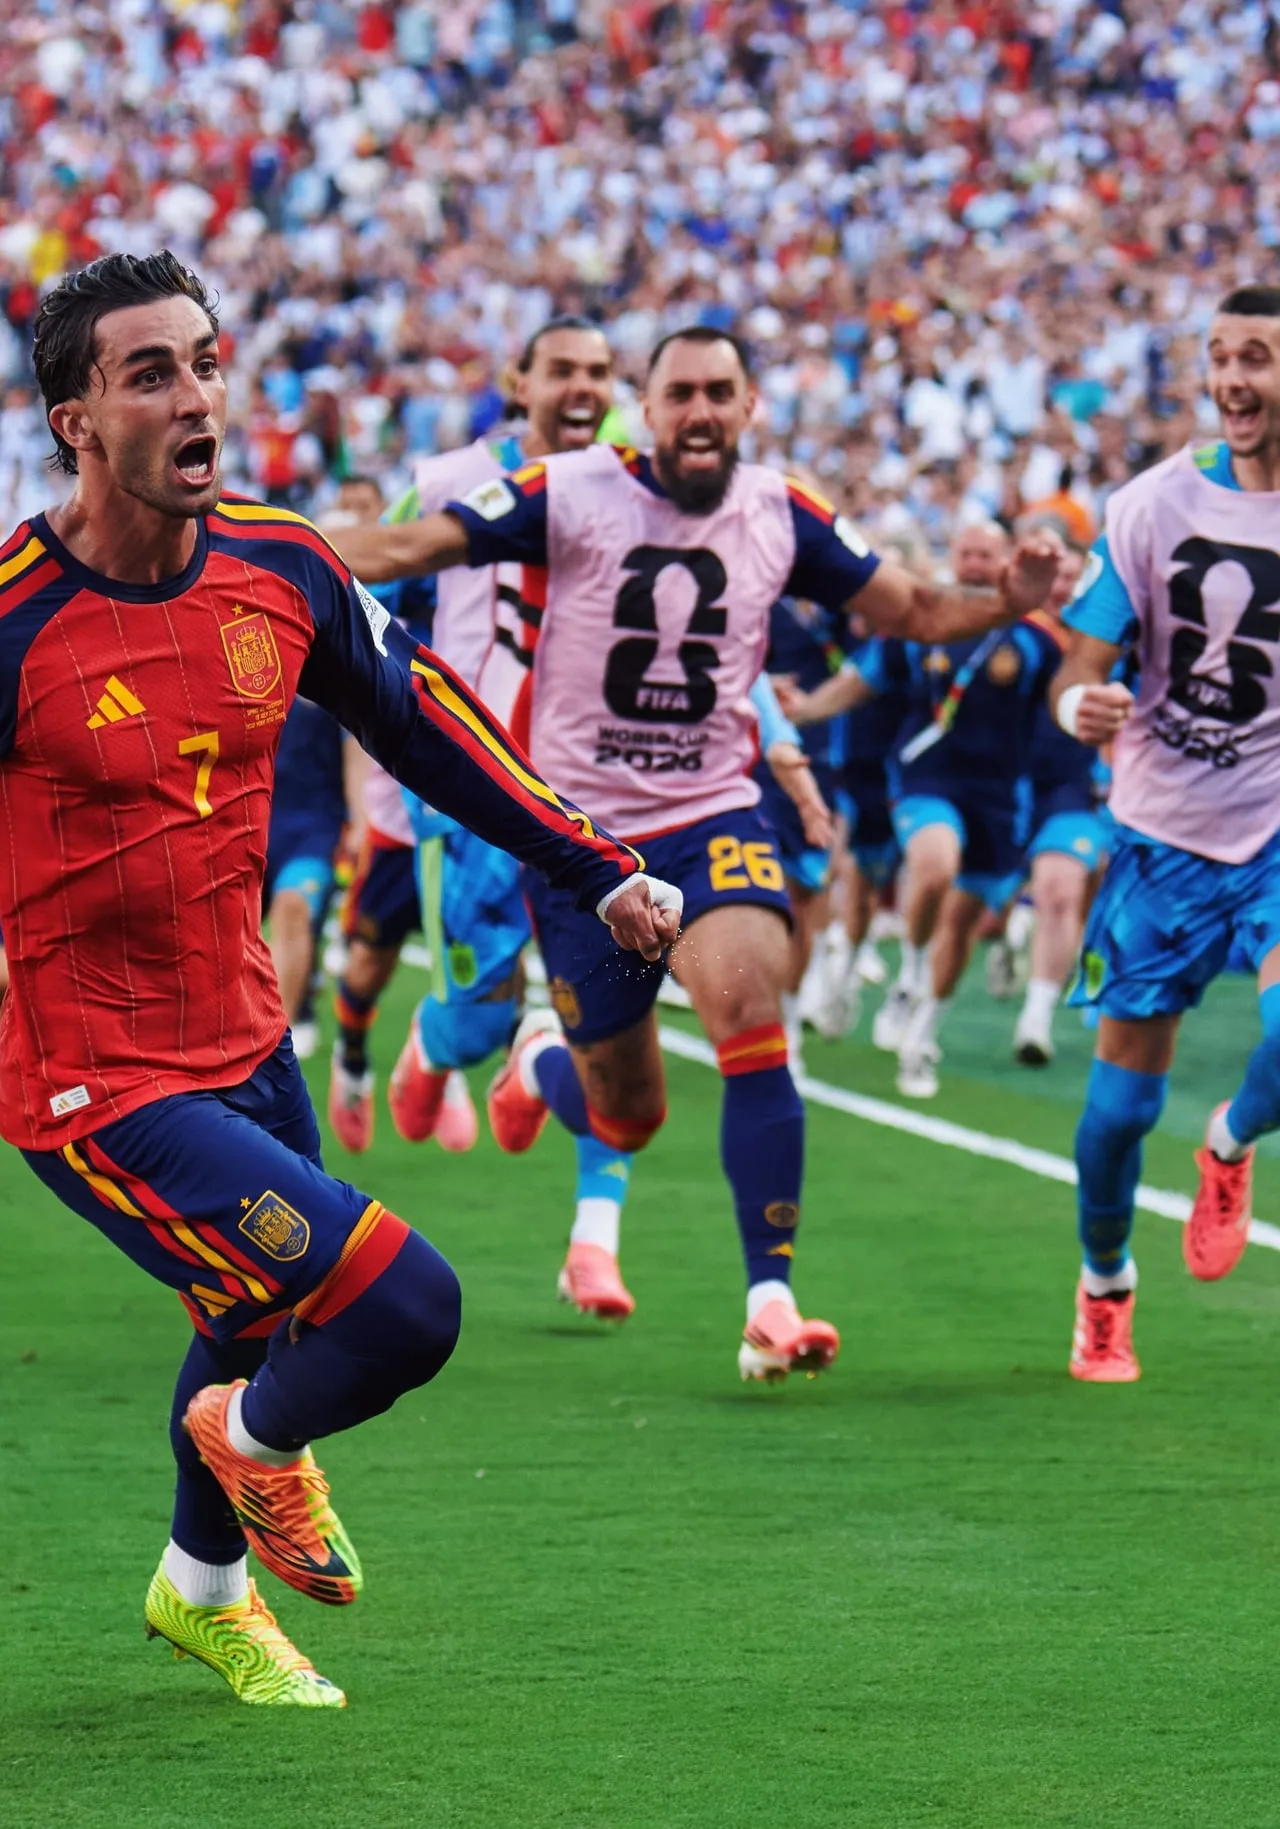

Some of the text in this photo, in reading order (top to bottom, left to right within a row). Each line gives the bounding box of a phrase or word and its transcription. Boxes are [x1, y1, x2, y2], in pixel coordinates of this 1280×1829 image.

[635, 685, 691, 711] FIFA
[178, 731, 219, 818] 7
[594, 744, 703, 772] 2026
[707, 834, 785, 892] 26
